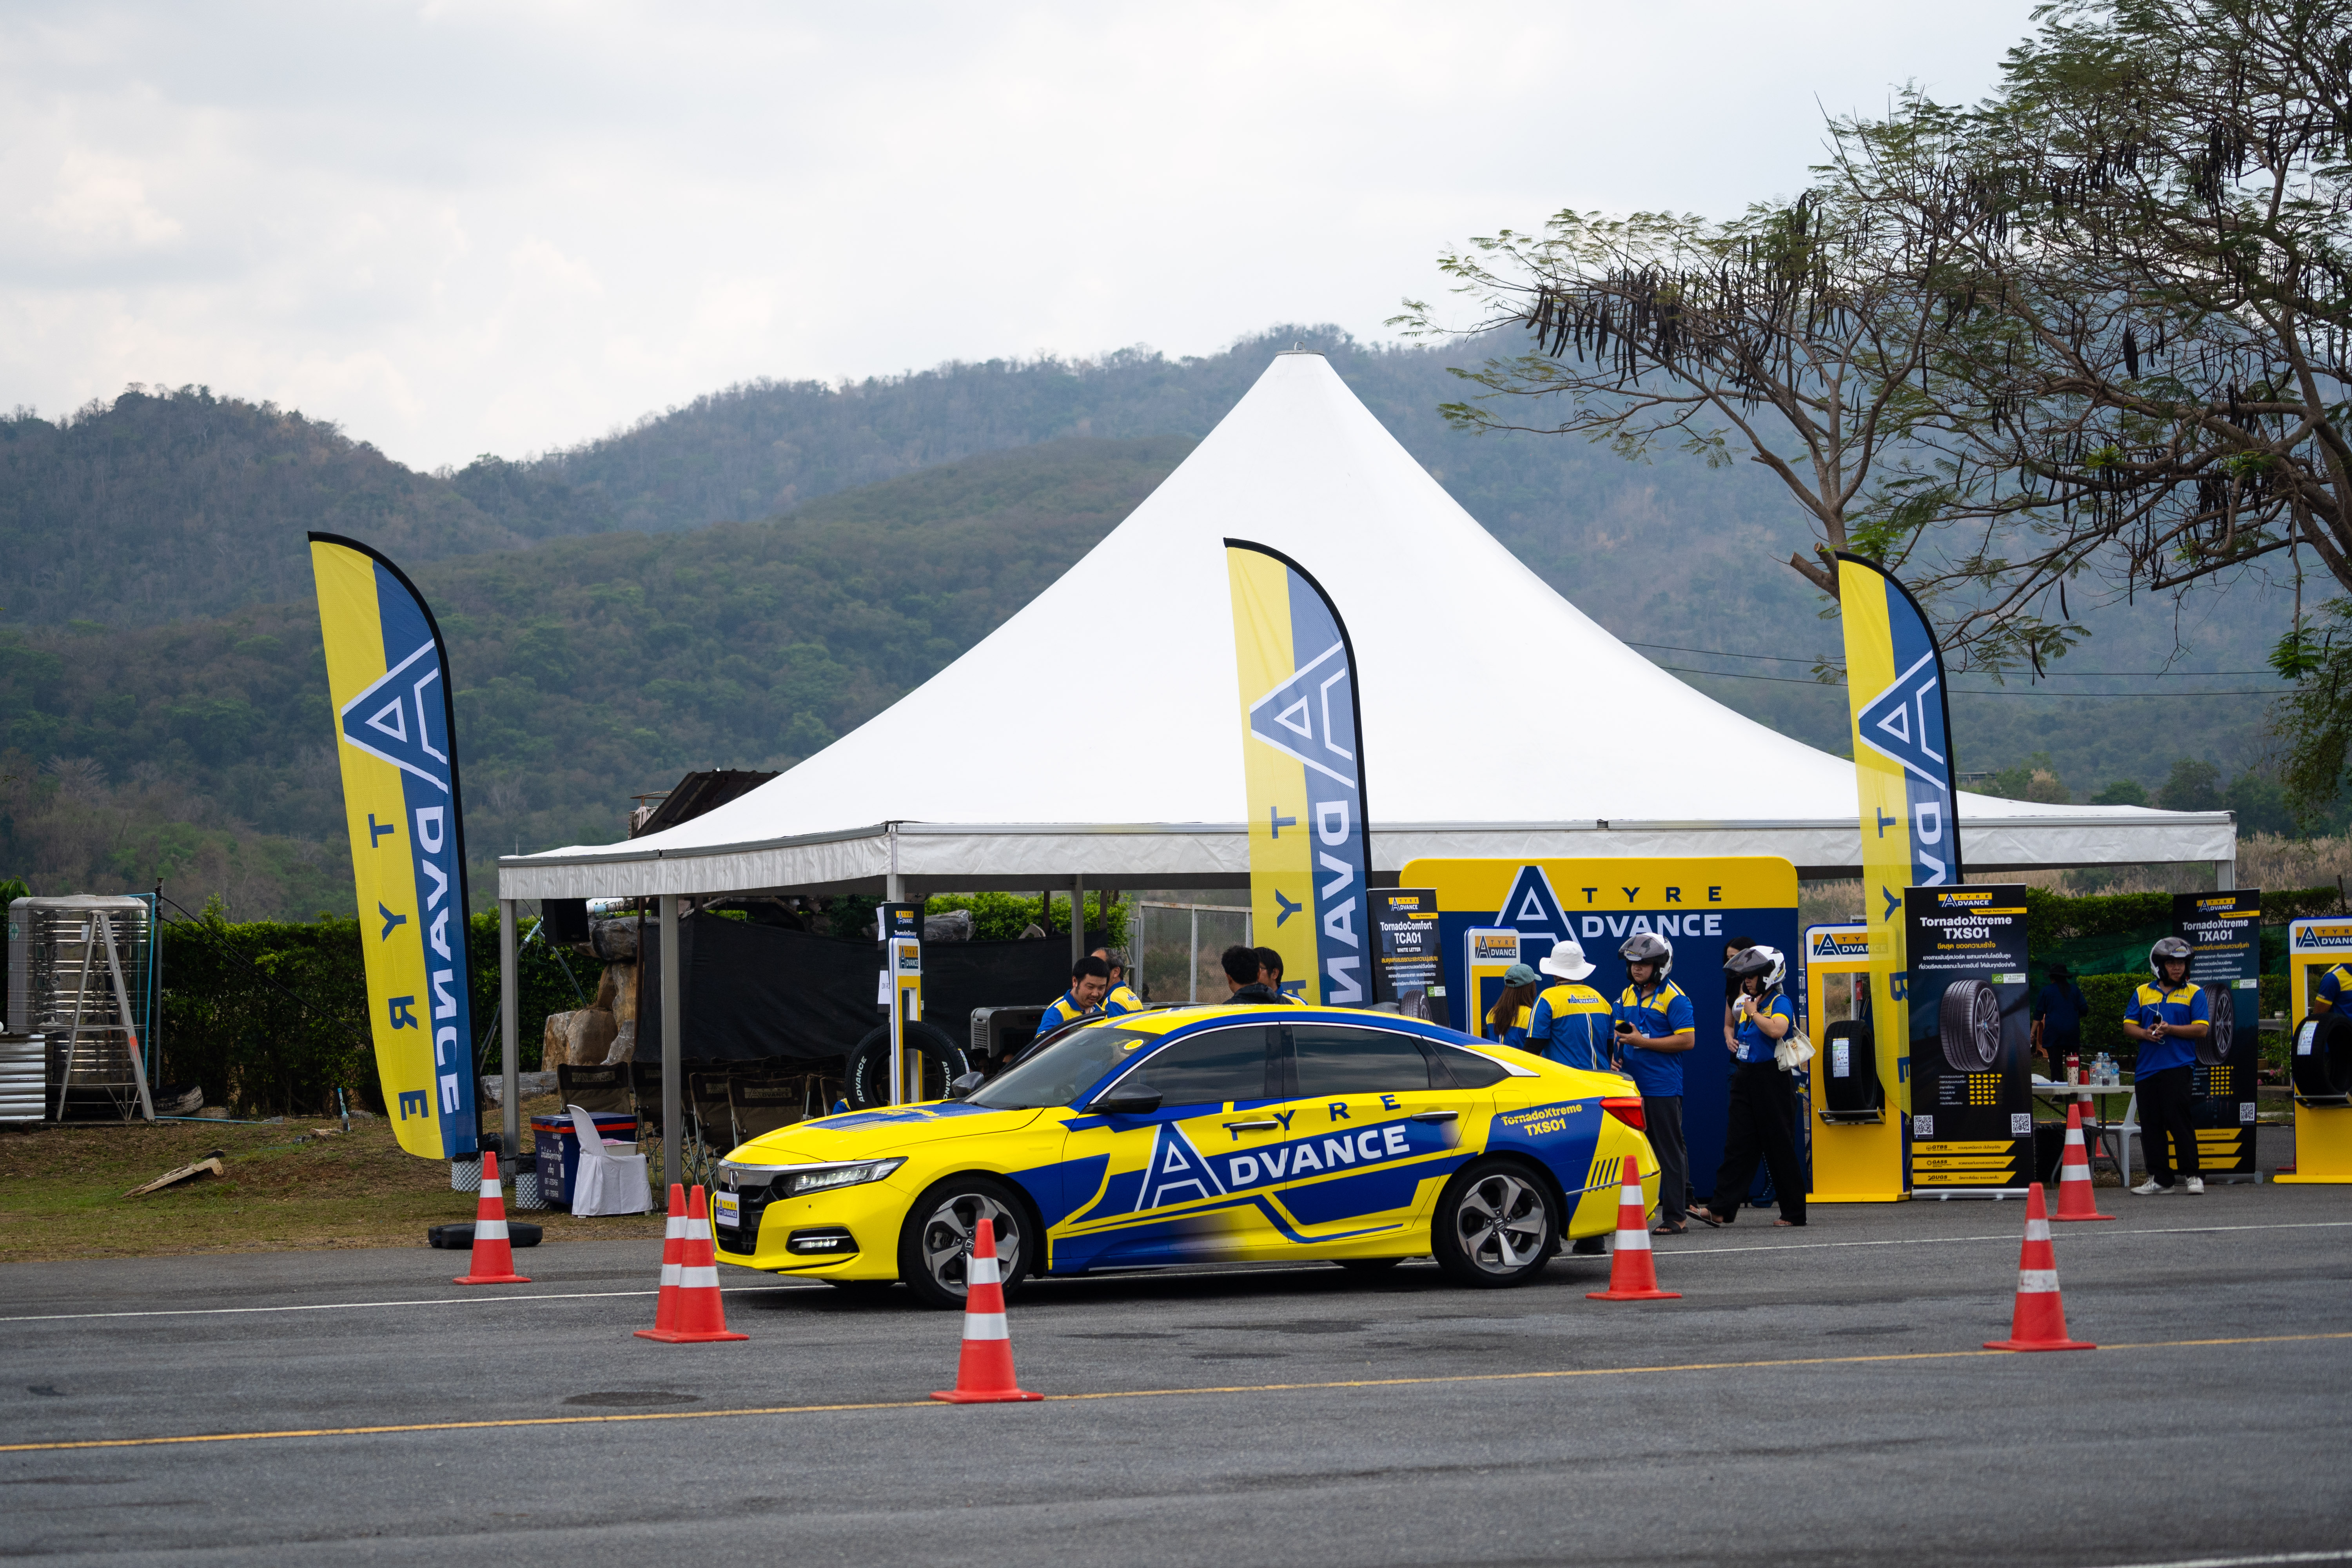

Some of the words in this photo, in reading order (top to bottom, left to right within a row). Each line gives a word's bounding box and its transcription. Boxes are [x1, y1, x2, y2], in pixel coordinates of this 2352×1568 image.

[1582, 886, 1722, 903] TYRE
[1942, 893, 1989, 907] ADVANCE
[1392, 897, 1418, 911] ADVANCE
[1494, 866, 1722, 956] ADVANCE
[2199, 899, 2233, 913] ADVANCE
[1380, 920, 1432, 931] TornadoComfort
[1920, 916, 2012, 927] TornadoXtreme
[2183, 919, 2249, 931] TornadoXtreme
[1394, 932, 1421, 944] TCA01
[1944, 927, 1989, 939] TXS01
[2198, 929, 2232, 942] TXA01
[1476, 936, 1515, 958] ADVANCE
[1937, 943, 1954, 951] ขีดสุด
[899, 946, 918, 969] ADVANCE
[1570, 995, 1599, 1004] ADVANCE
[856, 1056, 867, 1103] ADVANCE
[942, 1061, 951, 1100] ADVANC
[748, 1088, 789, 1098] ADVANCE
[1501, 1104, 1582, 1126] TornadoXtreme
[1524, 1118, 1566, 1136] TXS01
[1134, 1122, 1410, 1212] ADVANCE
[719, 1199, 737, 1217] ADVANCE
